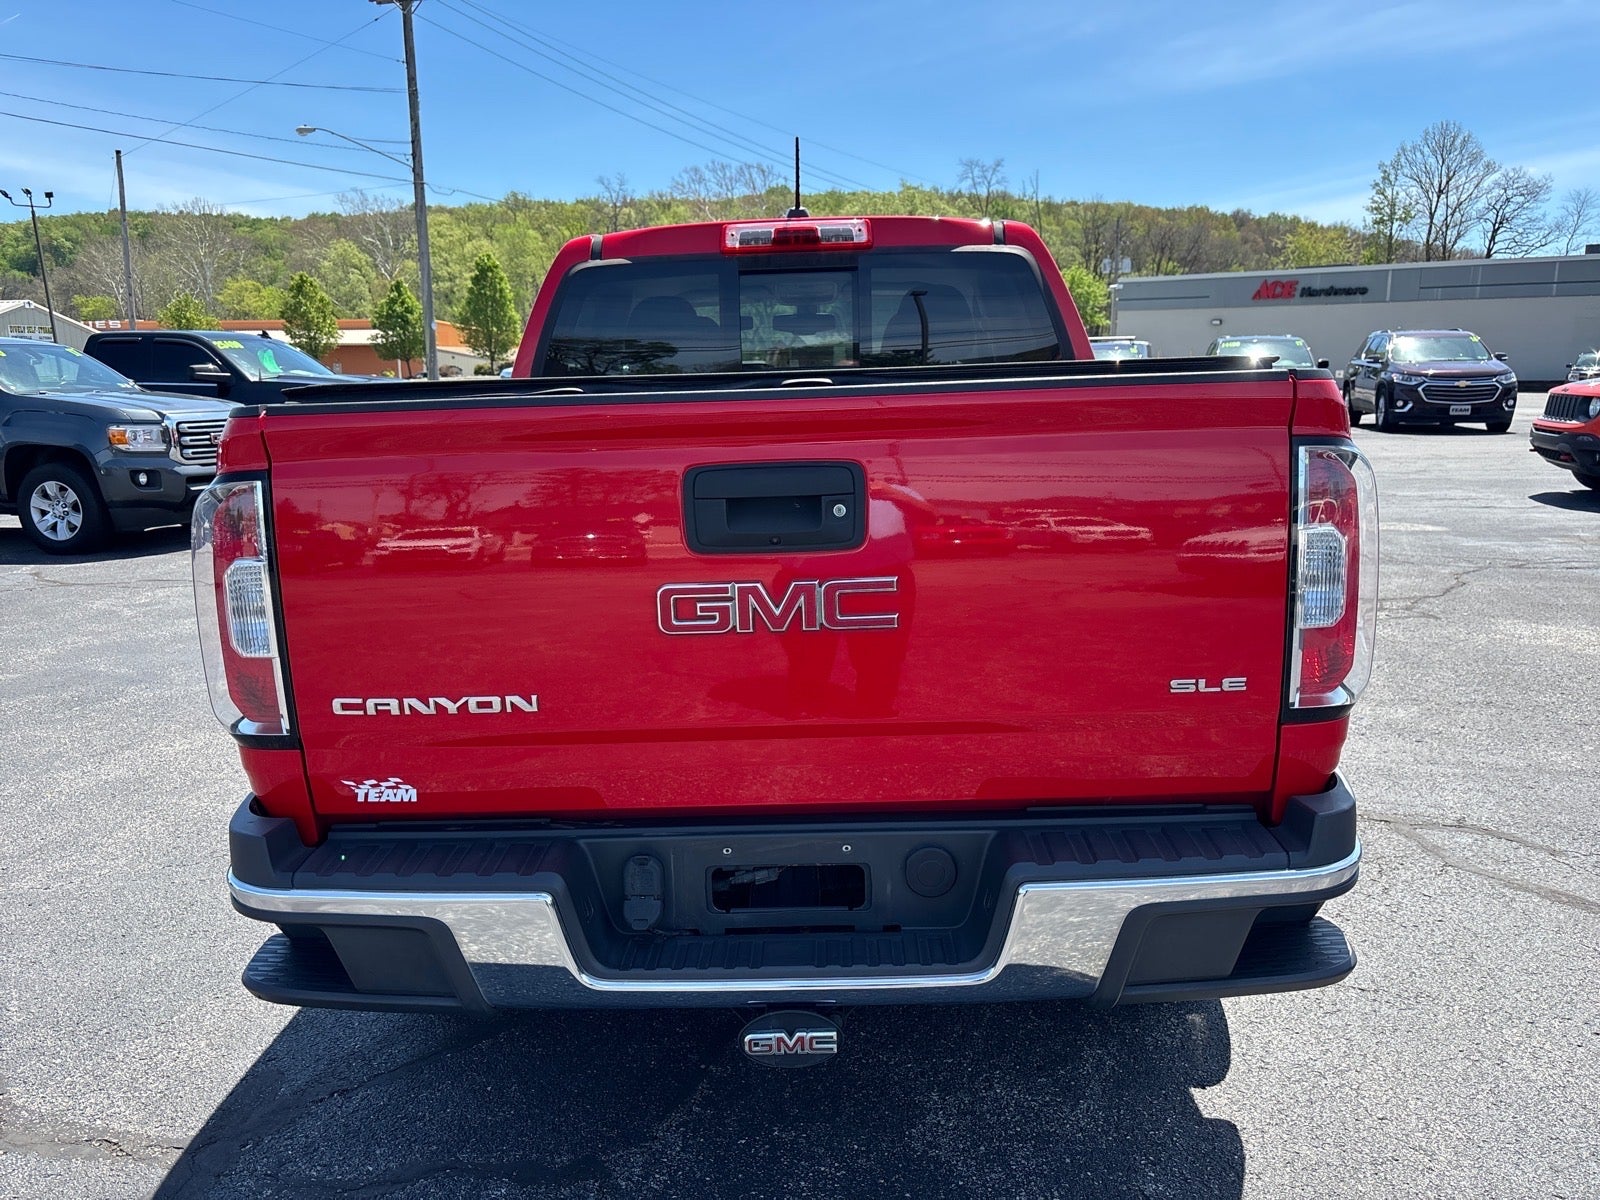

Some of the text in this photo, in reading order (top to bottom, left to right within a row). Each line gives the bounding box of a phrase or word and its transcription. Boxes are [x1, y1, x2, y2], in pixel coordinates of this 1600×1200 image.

[1252, 279, 1369, 300] ACE Hardware
[656, 576, 899, 635] GMC
[1169, 677, 1247, 693] SLE
[332, 694, 538, 716] CANYON
[354, 787, 418, 803] TEAM
[744, 1031, 838, 1056] GMC
